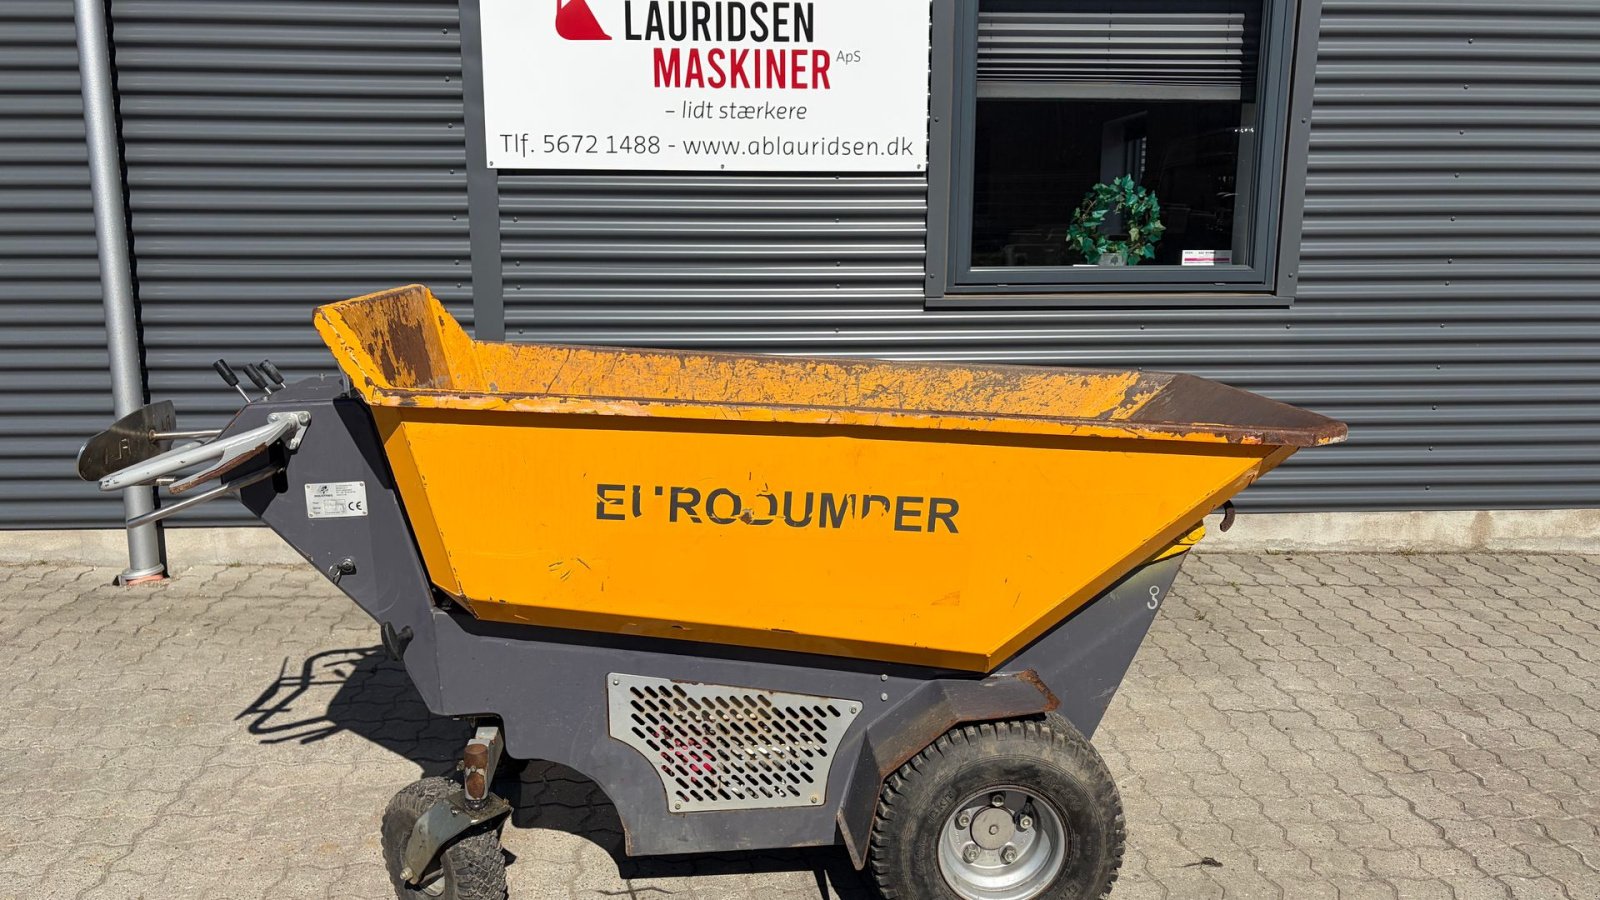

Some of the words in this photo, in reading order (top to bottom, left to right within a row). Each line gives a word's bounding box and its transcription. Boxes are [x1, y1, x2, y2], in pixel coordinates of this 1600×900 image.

[624, 0, 814, 42] LAURIDSEN
[653, 47, 831, 89] MASKINER
[835, 50, 861, 64] ApS
[682, 100, 713, 119] lidt
[718, 102, 808, 120] stærkere
[500, 133, 535, 157] Tlf.
[543, 134, 598, 154] 5672
[606, 135, 661, 155] 1488
[682, 135, 914, 156] www.ablauridsen.dk
